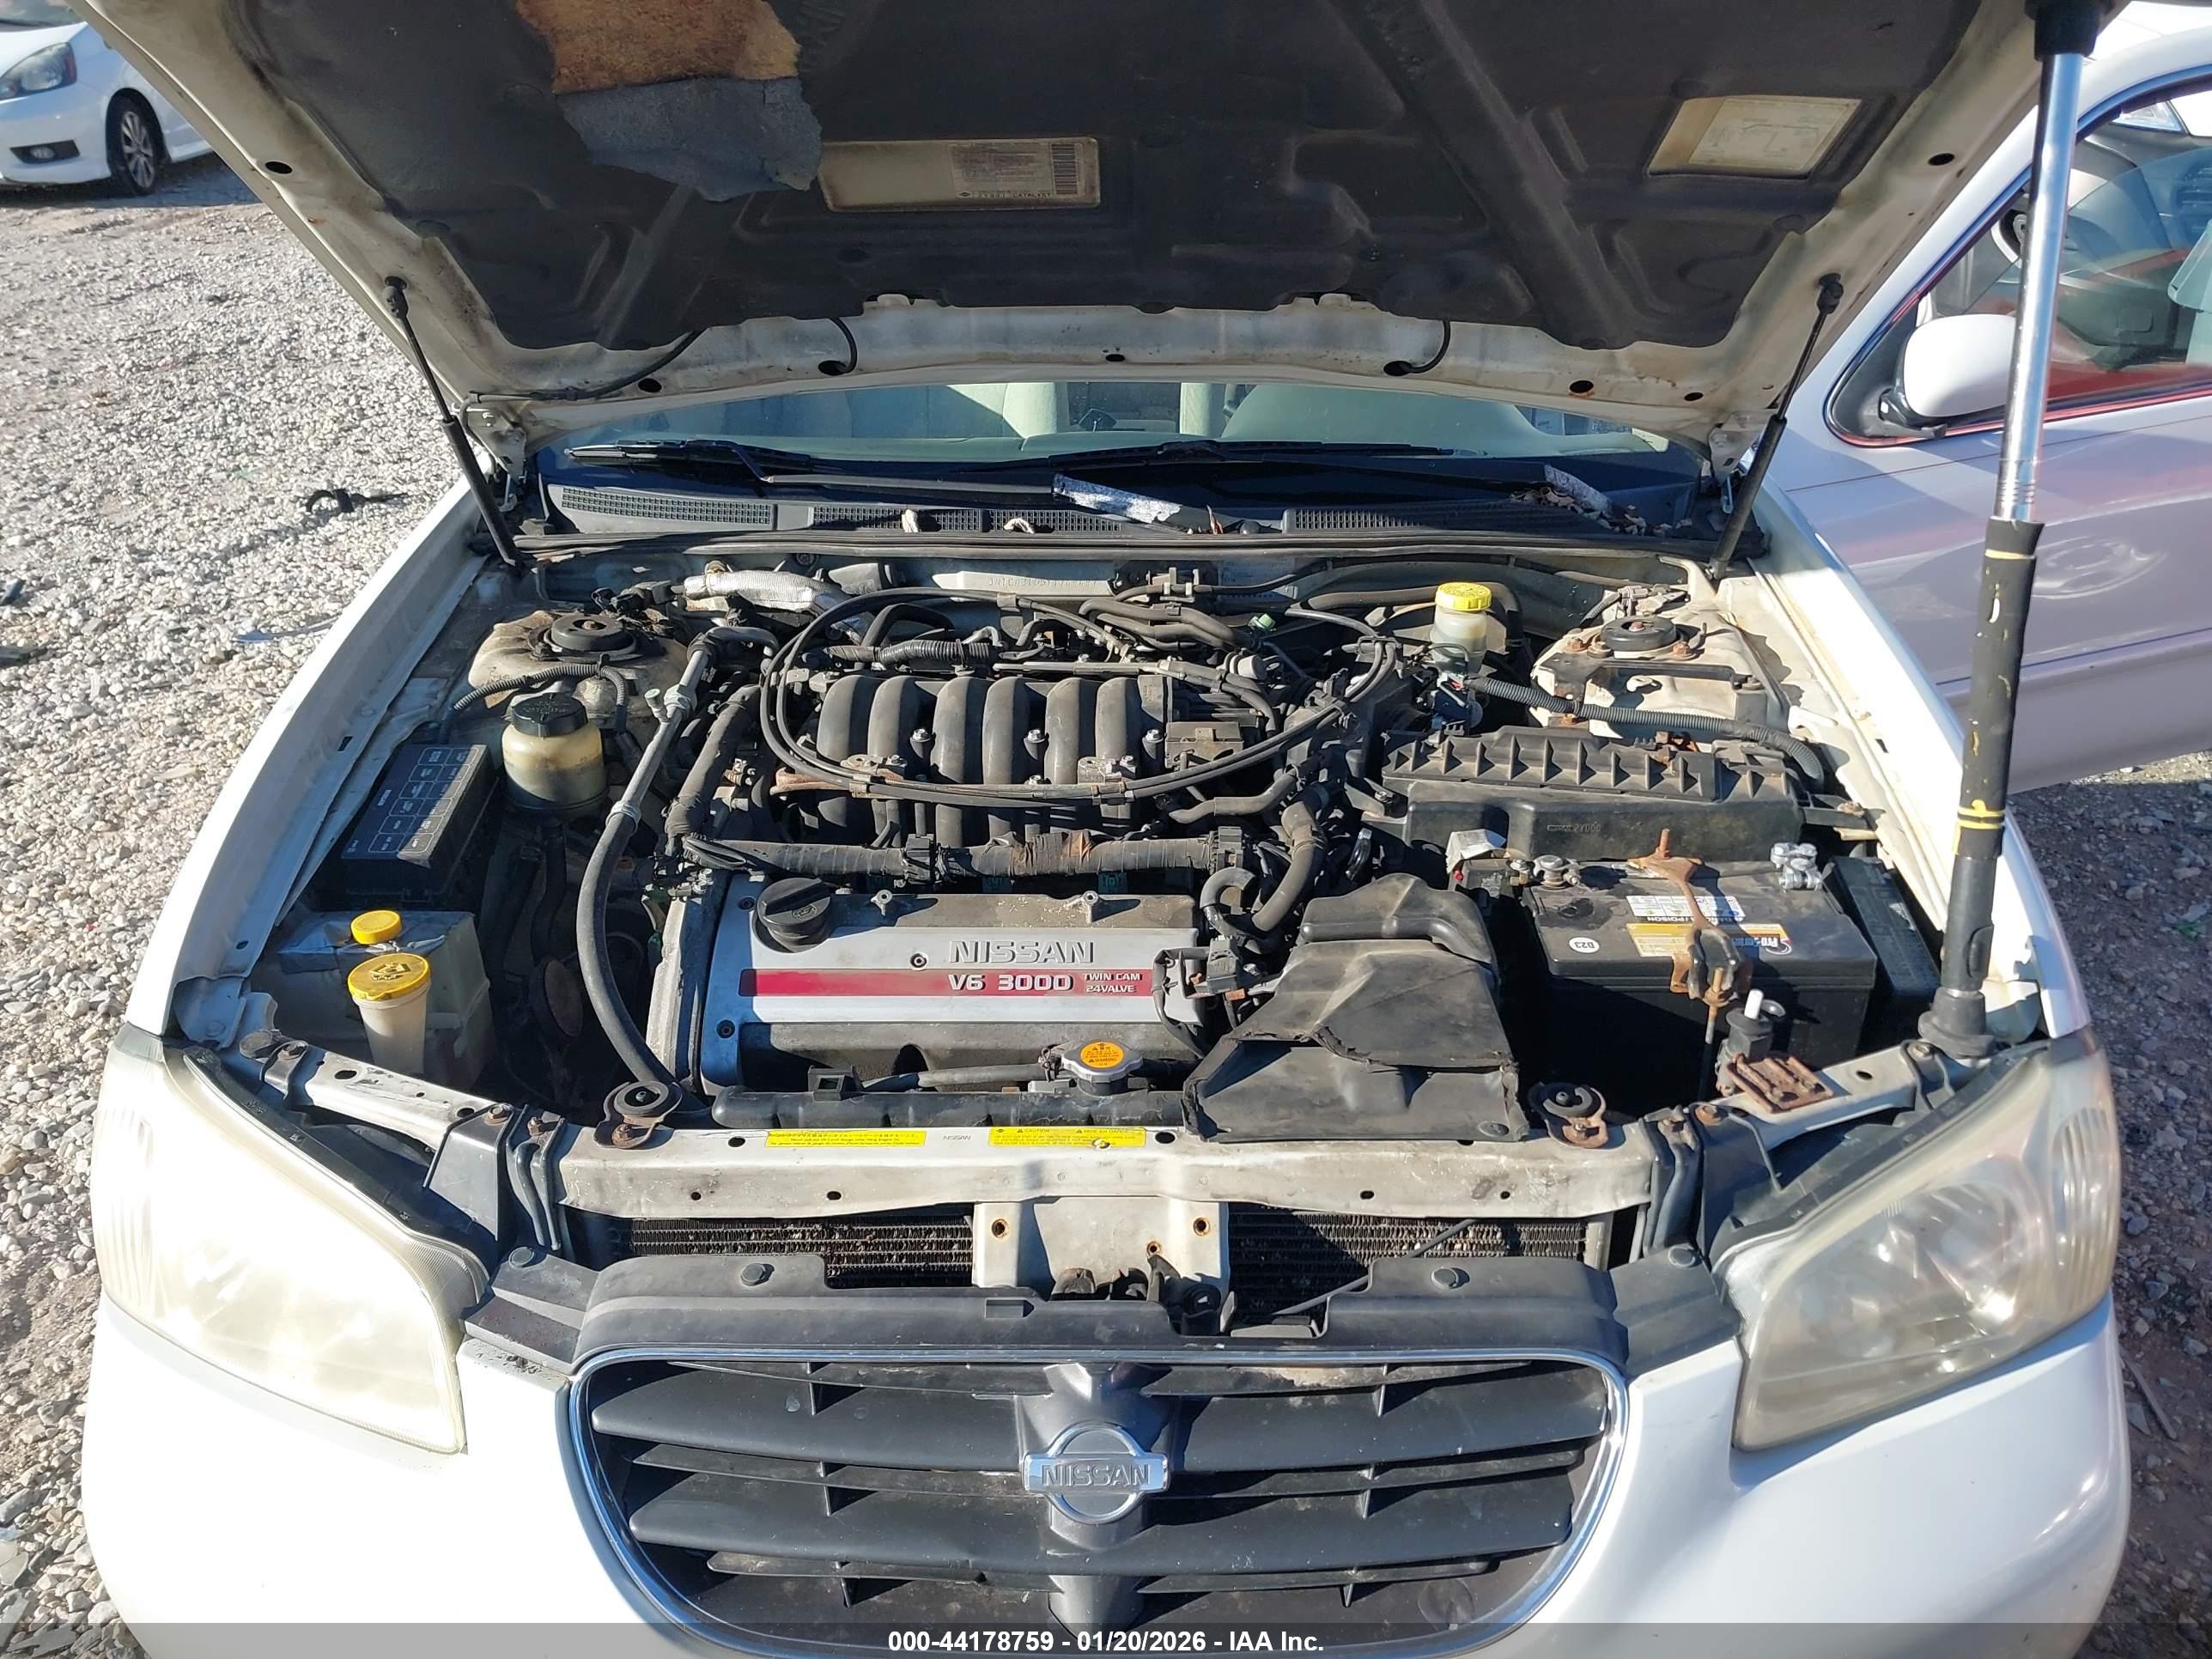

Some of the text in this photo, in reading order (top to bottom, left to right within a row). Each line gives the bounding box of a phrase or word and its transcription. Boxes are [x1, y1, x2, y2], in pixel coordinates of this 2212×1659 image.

[950, 941, 1095, 963] NISSAN
[948, 974, 1073, 991] V6 3000
[1042, 1464, 1151, 1486] NISSAN
